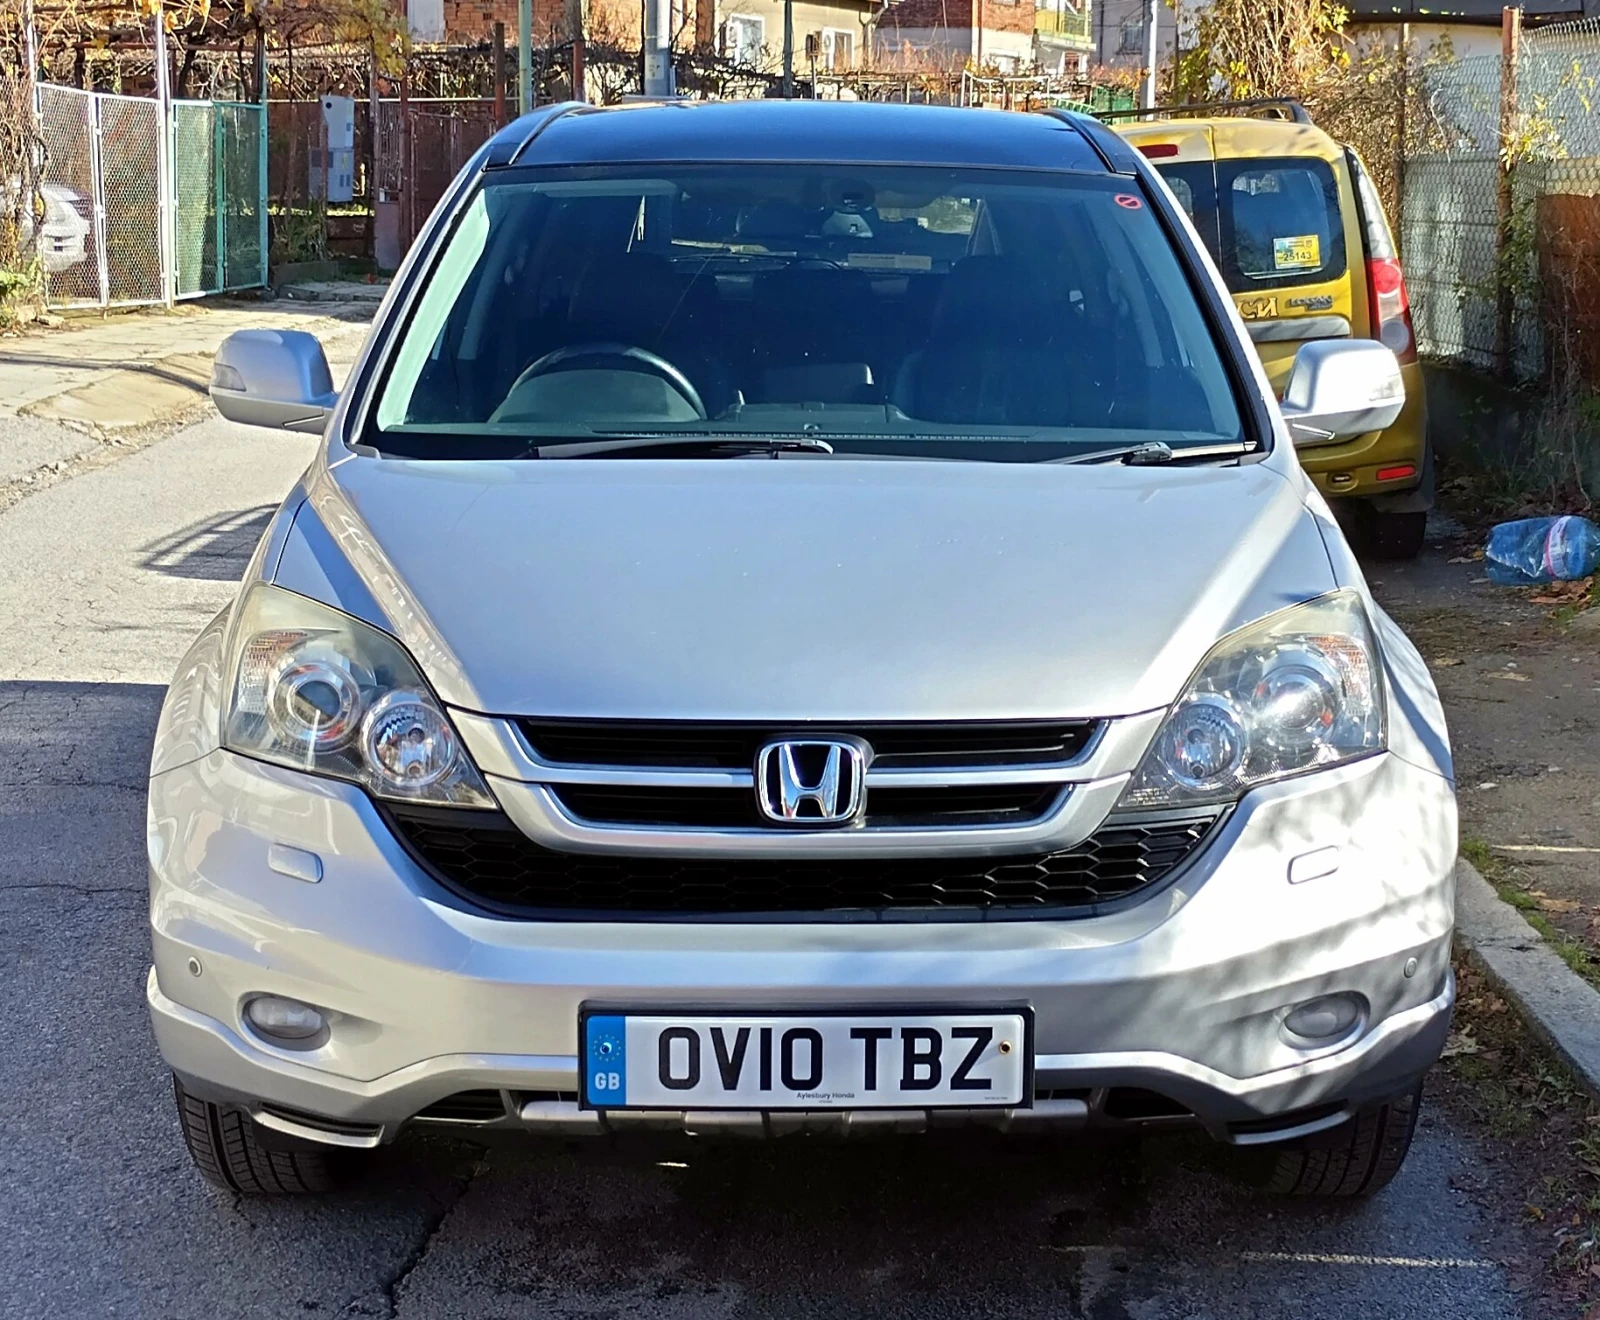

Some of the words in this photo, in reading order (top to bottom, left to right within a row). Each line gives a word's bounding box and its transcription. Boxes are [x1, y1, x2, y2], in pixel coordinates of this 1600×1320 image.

[1283, 251, 1312, 261] 25143
[850, 1027, 993, 1091] TBZ
[595, 1072, 620, 1090] GB
[796, 1092, 831, 1100] Aylesbury
